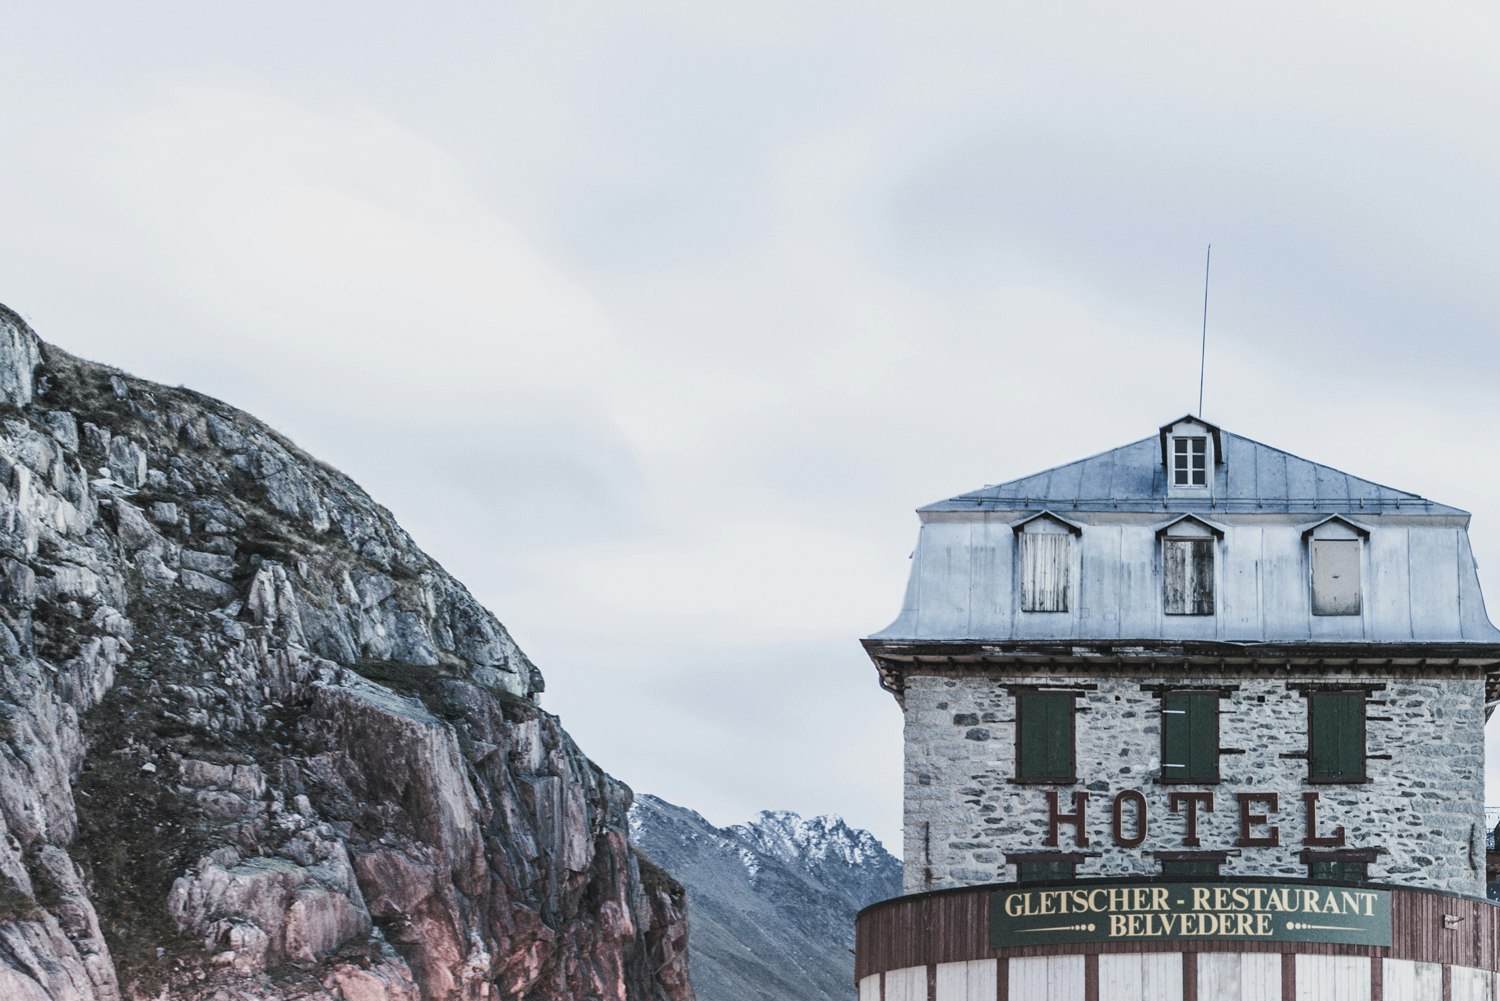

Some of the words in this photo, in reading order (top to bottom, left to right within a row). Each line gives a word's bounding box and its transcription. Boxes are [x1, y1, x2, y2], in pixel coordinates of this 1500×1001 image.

[1044, 789, 1346, 848] HOTEL
[1004, 887, 1170, 917] GLETSCHER
[1191, 887, 1378, 917] RESTAURANT
[1108, 912, 1274, 937] BELVEDERE
